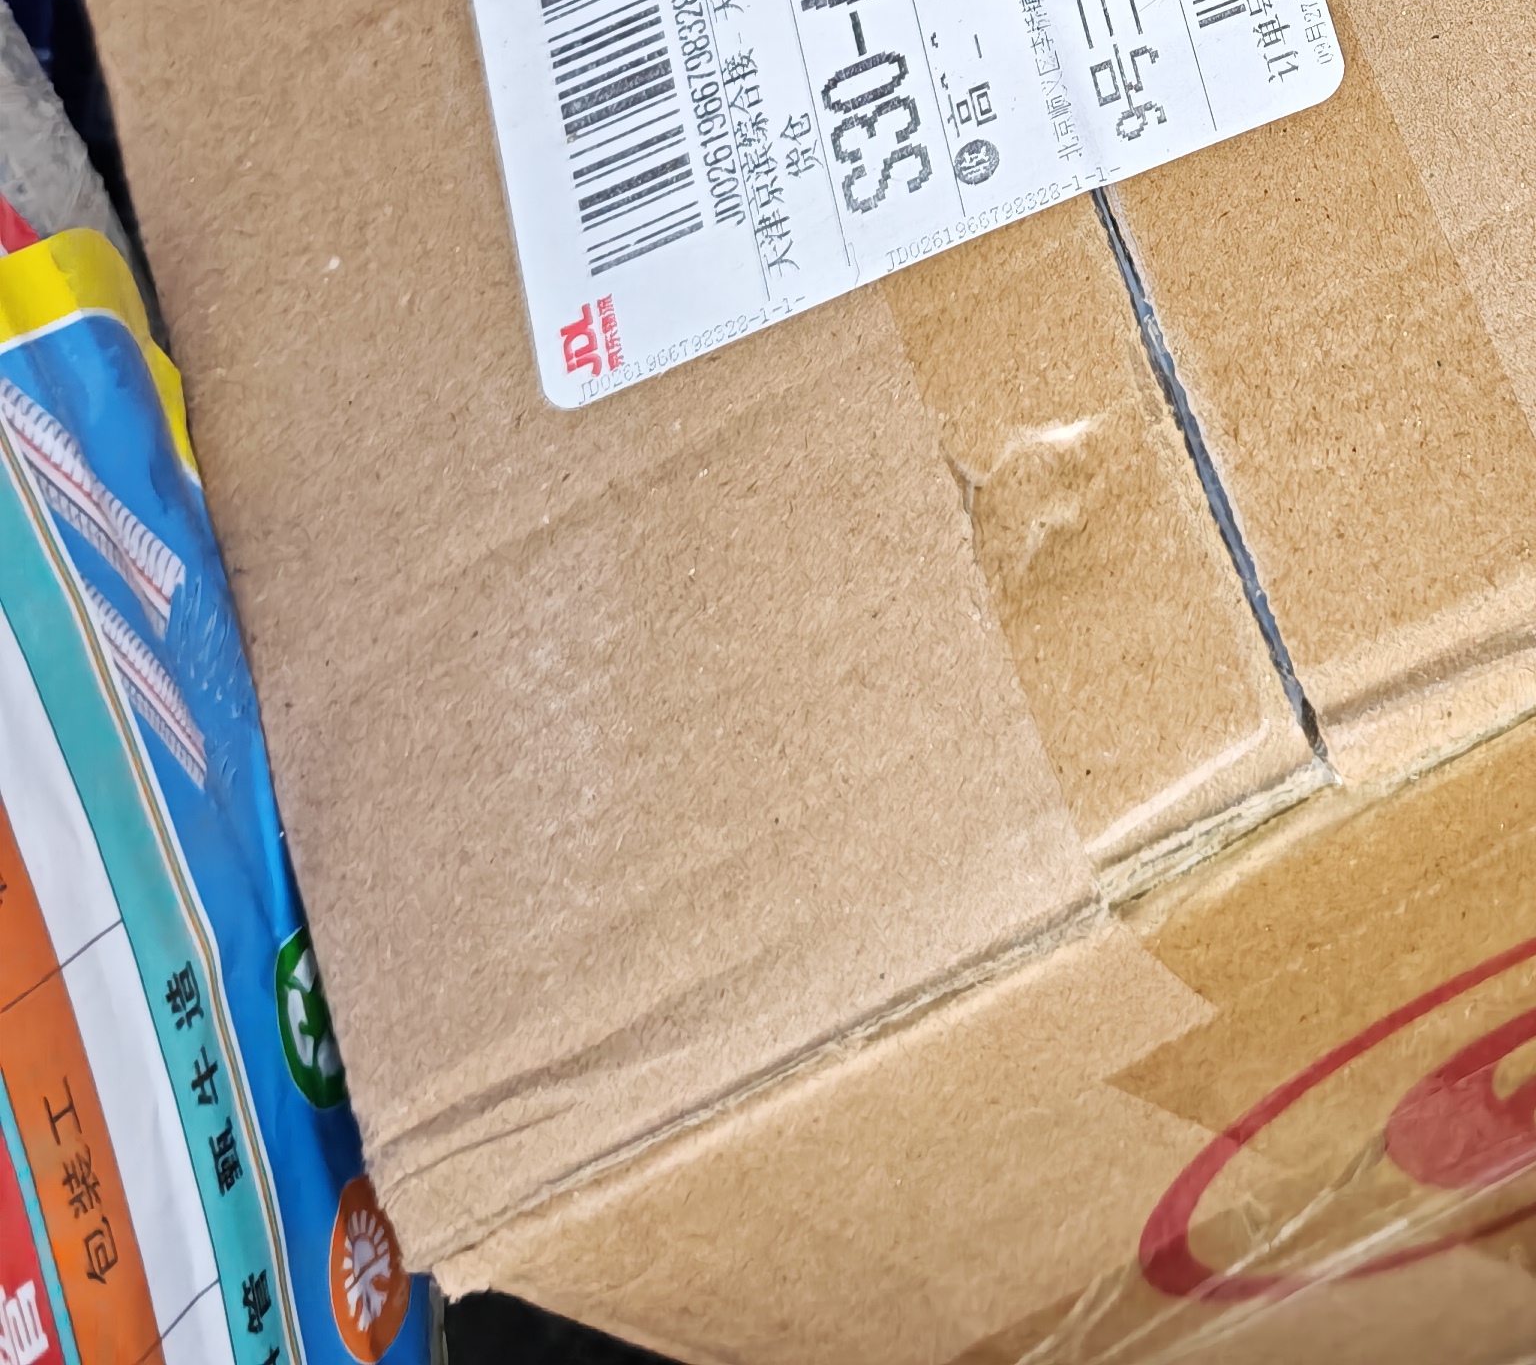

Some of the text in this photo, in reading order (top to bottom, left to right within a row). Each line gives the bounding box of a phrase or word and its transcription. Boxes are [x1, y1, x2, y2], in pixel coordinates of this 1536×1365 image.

[775, 106, 823, 181] 货仓
[556, 301, 603, 386] JDL
[43, 1076, 118, 1284] 包装工
